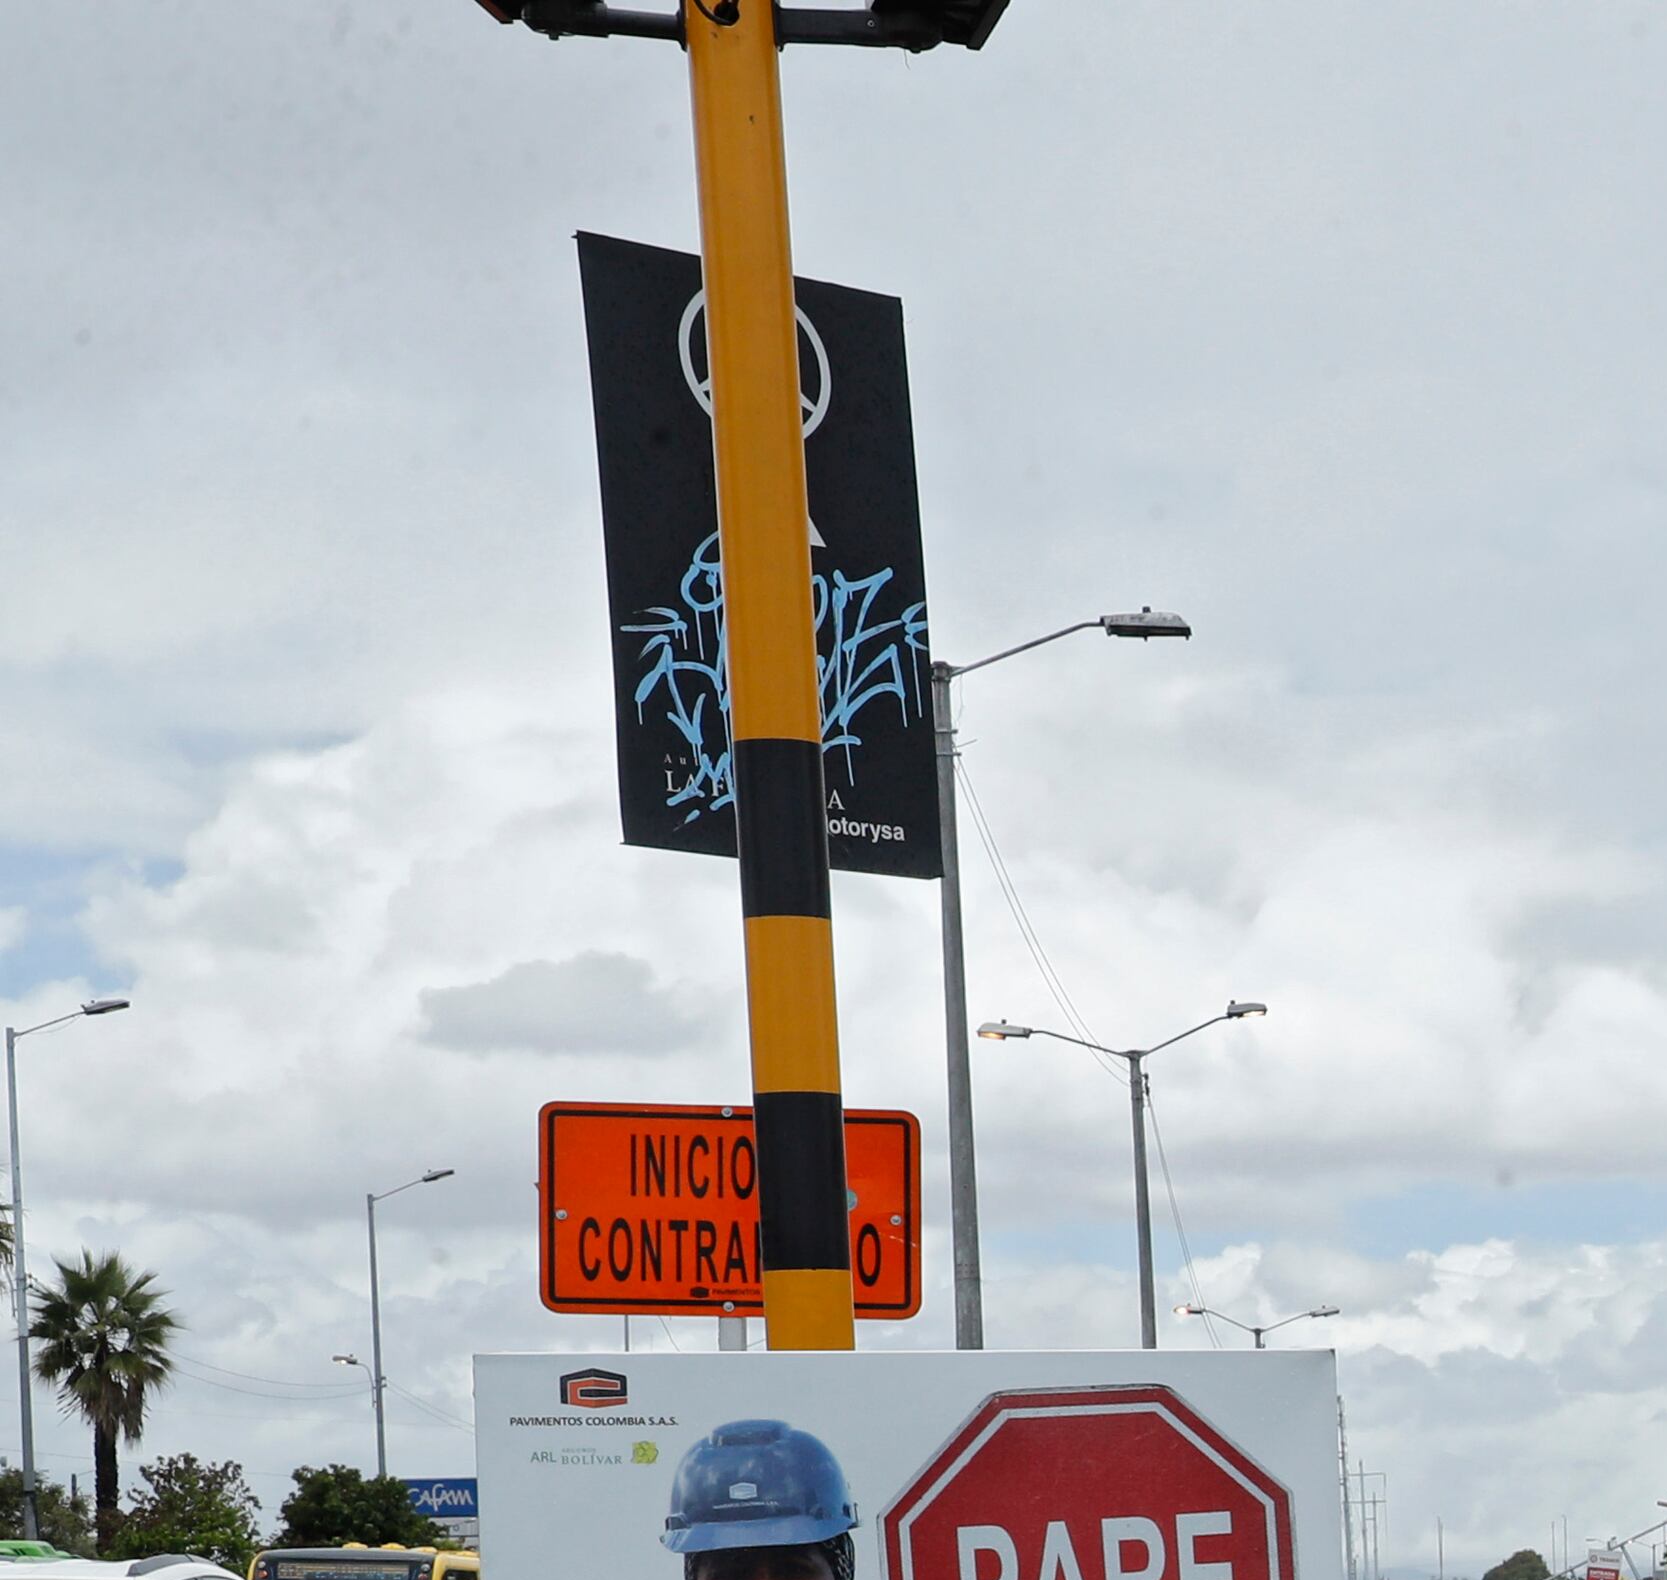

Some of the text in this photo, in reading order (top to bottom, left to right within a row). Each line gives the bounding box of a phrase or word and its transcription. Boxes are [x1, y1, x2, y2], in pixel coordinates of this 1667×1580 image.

[827, 816, 906, 843] otorysa
[629, 1132, 756, 1200] INICIO
[509, 1416, 679, 1427] PAVIMENTOS COLOMBIA S.A.S.
[530, 1451, 557, 1464] ARL
[560, 1453, 623, 1465] BOLÍVAR
